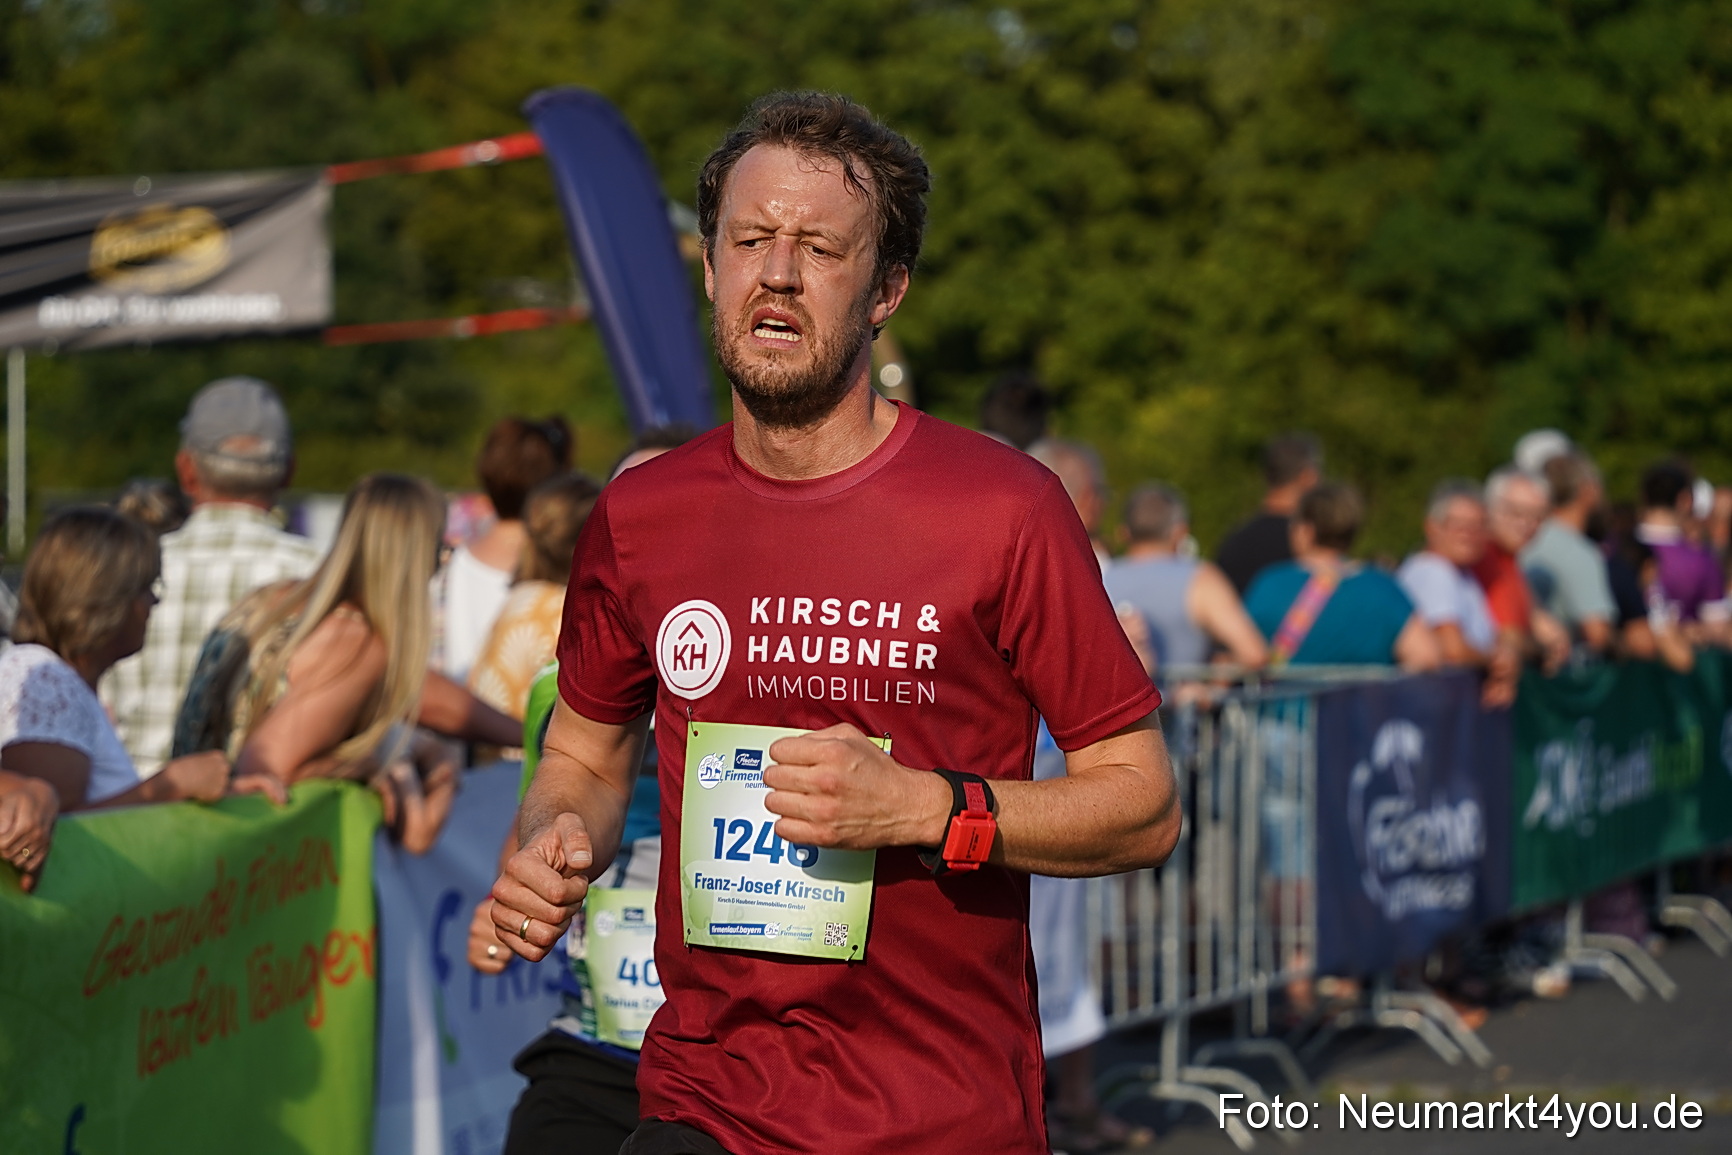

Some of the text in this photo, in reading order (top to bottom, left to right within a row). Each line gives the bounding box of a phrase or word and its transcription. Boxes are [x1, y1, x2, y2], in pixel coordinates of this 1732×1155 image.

[750, 597, 941, 633] KIRSCH &
[673, 642, 708, 672] KH
[748, 635, 938, 670] HAUBNER
[748, 675, 936, 705] IMMOBILIEN
[724, 770, 764, 781] Firmenl
[694, 872, 845, 903] Franz-Josef Kirsch
[717, 896, 731, 905] Kirsch
[736, 898, 756, 906] Haubner
[756, 900, 787, 909] Immobilien
[787, 903, 806, 911] GmbH
[711, 925, 762, 935] firmenlauf.bayern
[618, 957, 662, 987] 40
